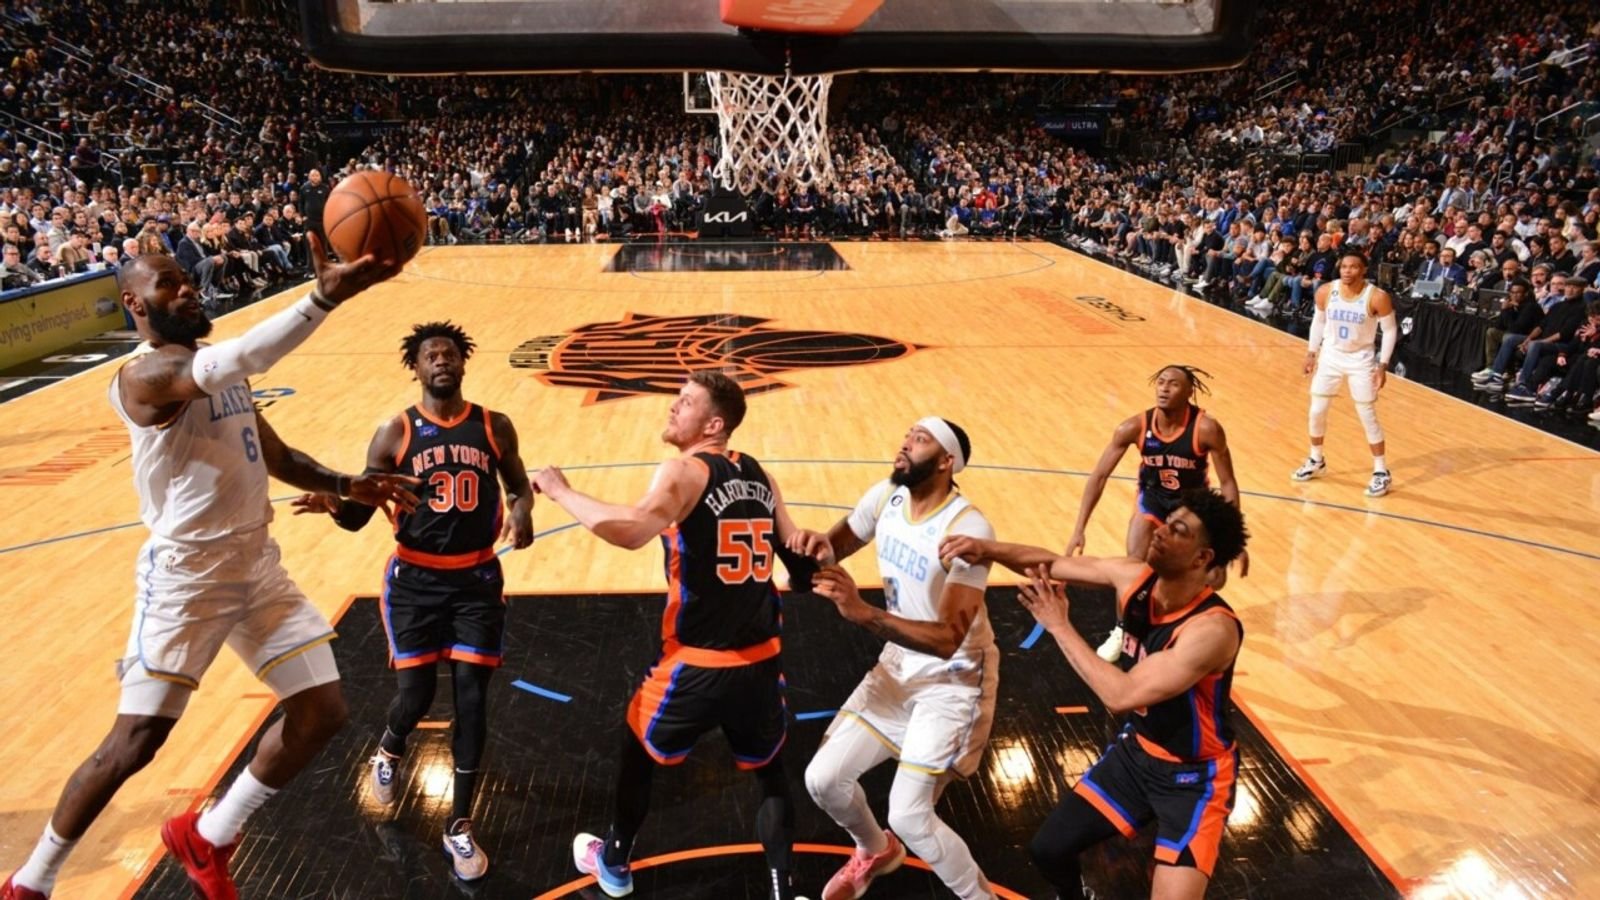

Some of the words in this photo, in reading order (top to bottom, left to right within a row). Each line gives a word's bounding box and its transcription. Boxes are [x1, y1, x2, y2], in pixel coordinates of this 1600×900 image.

[1071, 121, 1098, 129] ULTRA
[1339, 326, 1348, 339] 0
[242, 426, 258, 463] 6
[412, 445, 446, 477] NEW
[448, 444, 490, 474] YORK
[1166, 454, 1197, 470] YORK
[428, 470, 480, 513] 30
[1159, 468, 1181, 491] 5
[716, 518, 774, 585] 55
[880, 535, 929, 583] AKERS
